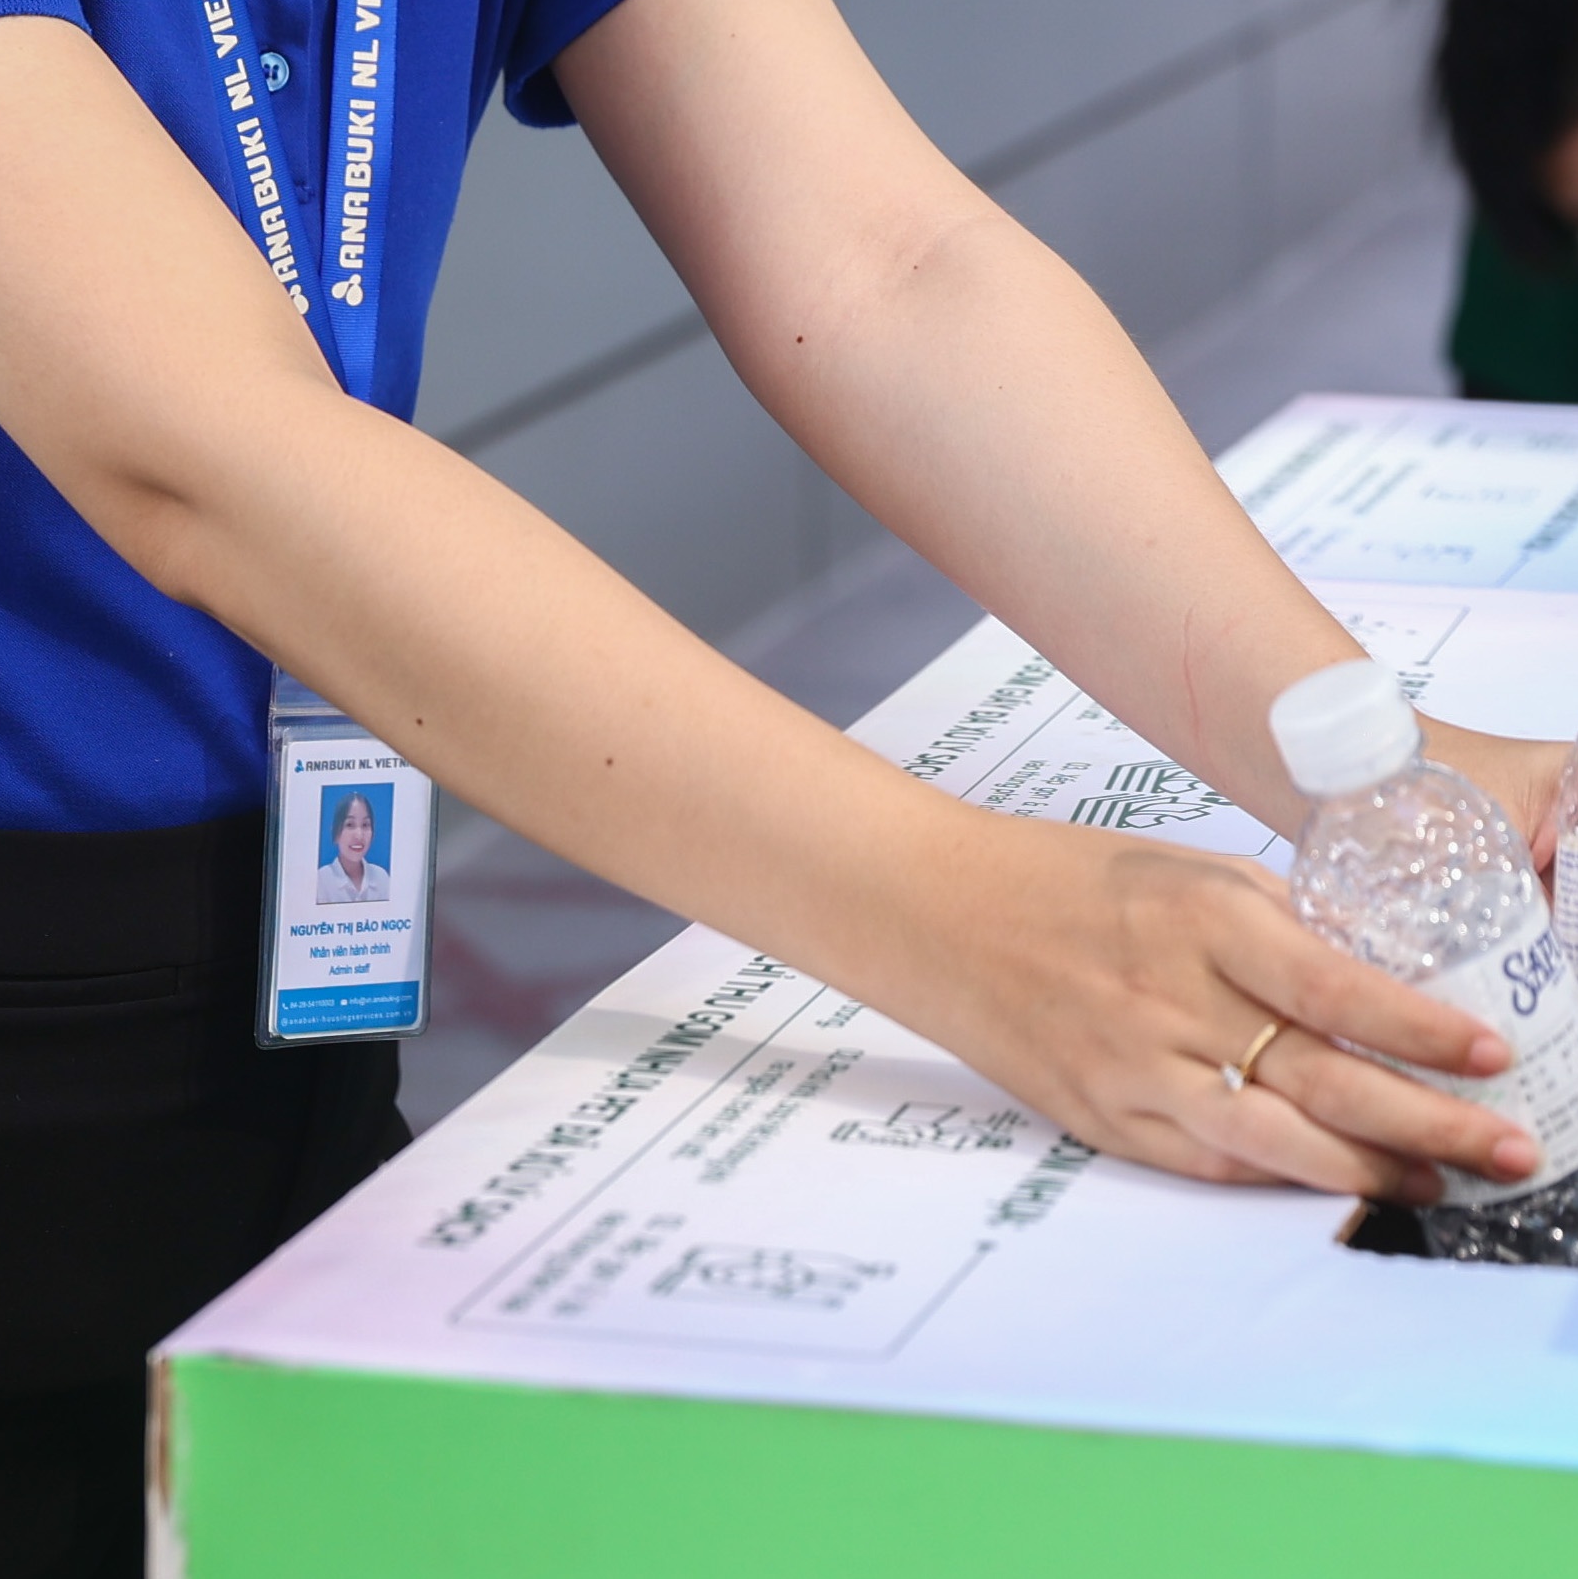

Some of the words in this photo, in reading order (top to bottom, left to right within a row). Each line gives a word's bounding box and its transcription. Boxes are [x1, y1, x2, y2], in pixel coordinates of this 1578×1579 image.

[352, 39, 380, 88] NL
[224, 58, 254, 107] NL
[339, 99, 376, 269] ANABUKI
[237, 117, 300, 280] ANABUKI
[306, 759, 356, 772] ANABUKI
[359, 759, 373, 770] NL
[337, 922, 354, 935] THỊ
[356, 919, 379, 933] BẢO
[381, 919, 412, 933] NGỌC
[310, 946, 330, 958] Nhân
[332, 945, 348, 957] viên
[349, 943, 368, 956] hành
[370, 942, 391, 955] chính
[329, 965, 352, 976] Admin
[354, 962, 371, 975] staff
[703, 981, 773, 1009] THU
